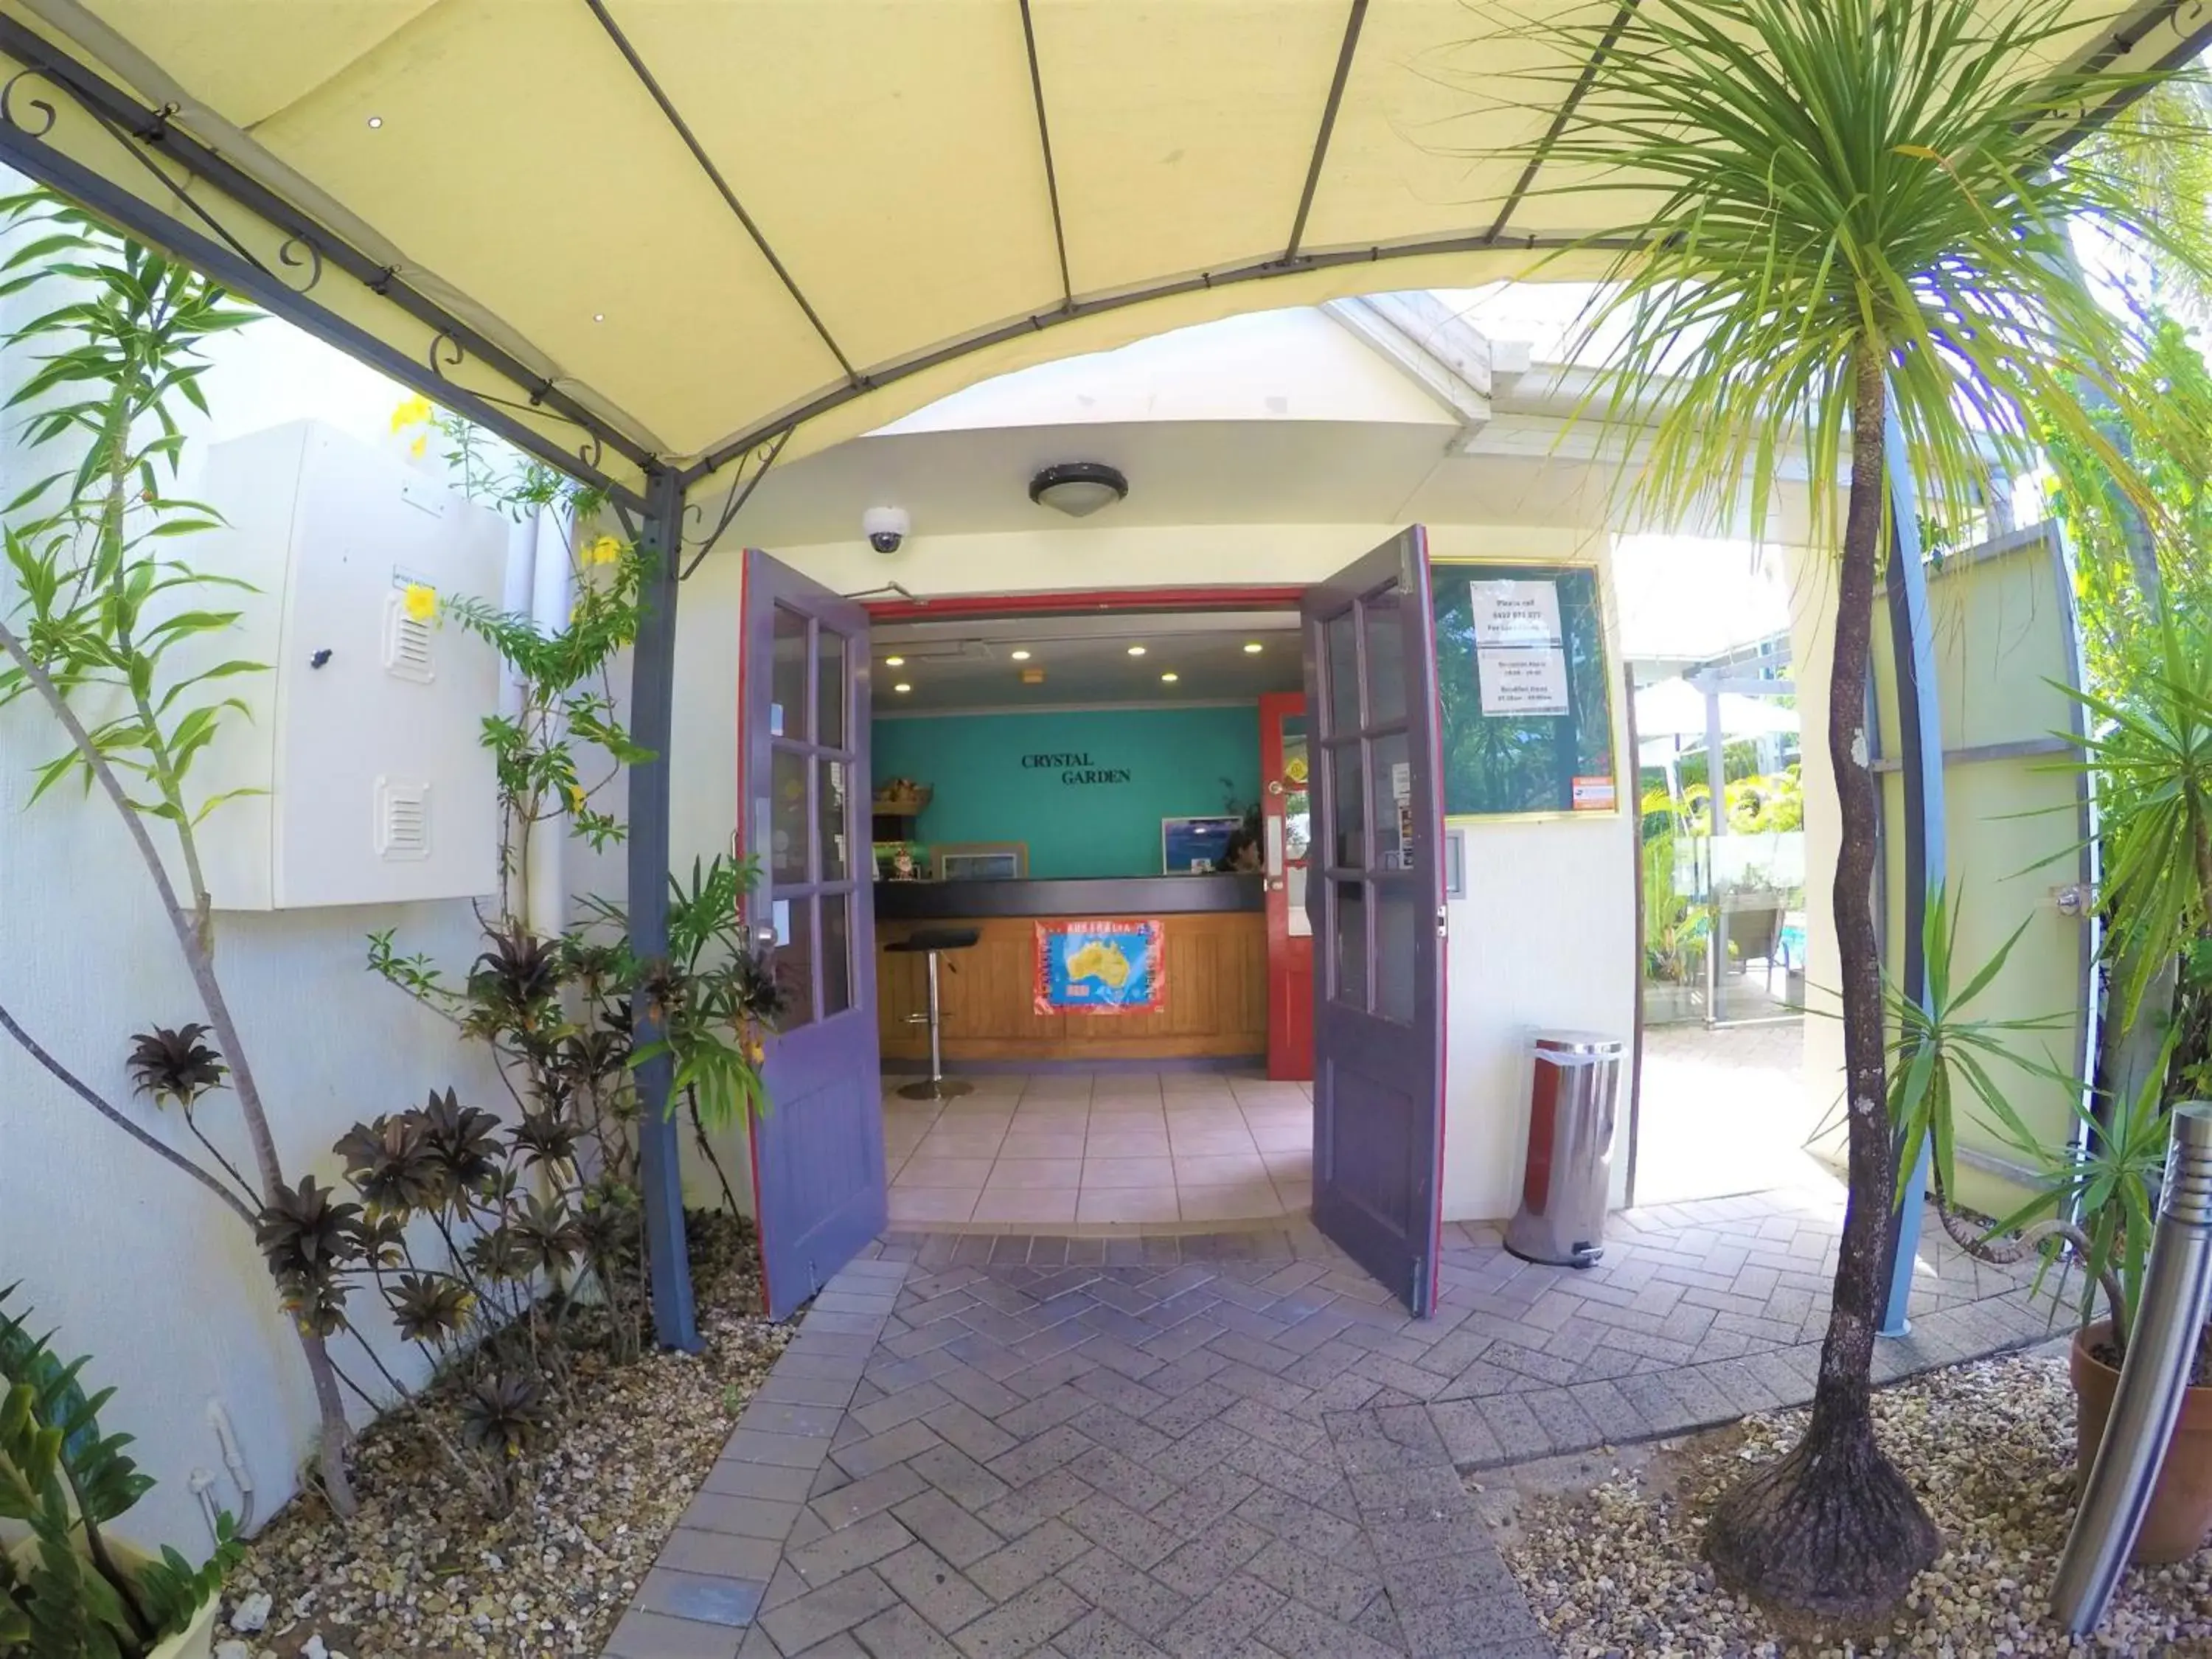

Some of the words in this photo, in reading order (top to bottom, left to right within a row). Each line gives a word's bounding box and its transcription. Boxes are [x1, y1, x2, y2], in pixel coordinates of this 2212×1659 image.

[1021, 753, 1094, 768] CRYSTAL
[1062, 768, 1131, 785] GARDEN
[1067, 922, 1131, 933] AUSTRALIA
